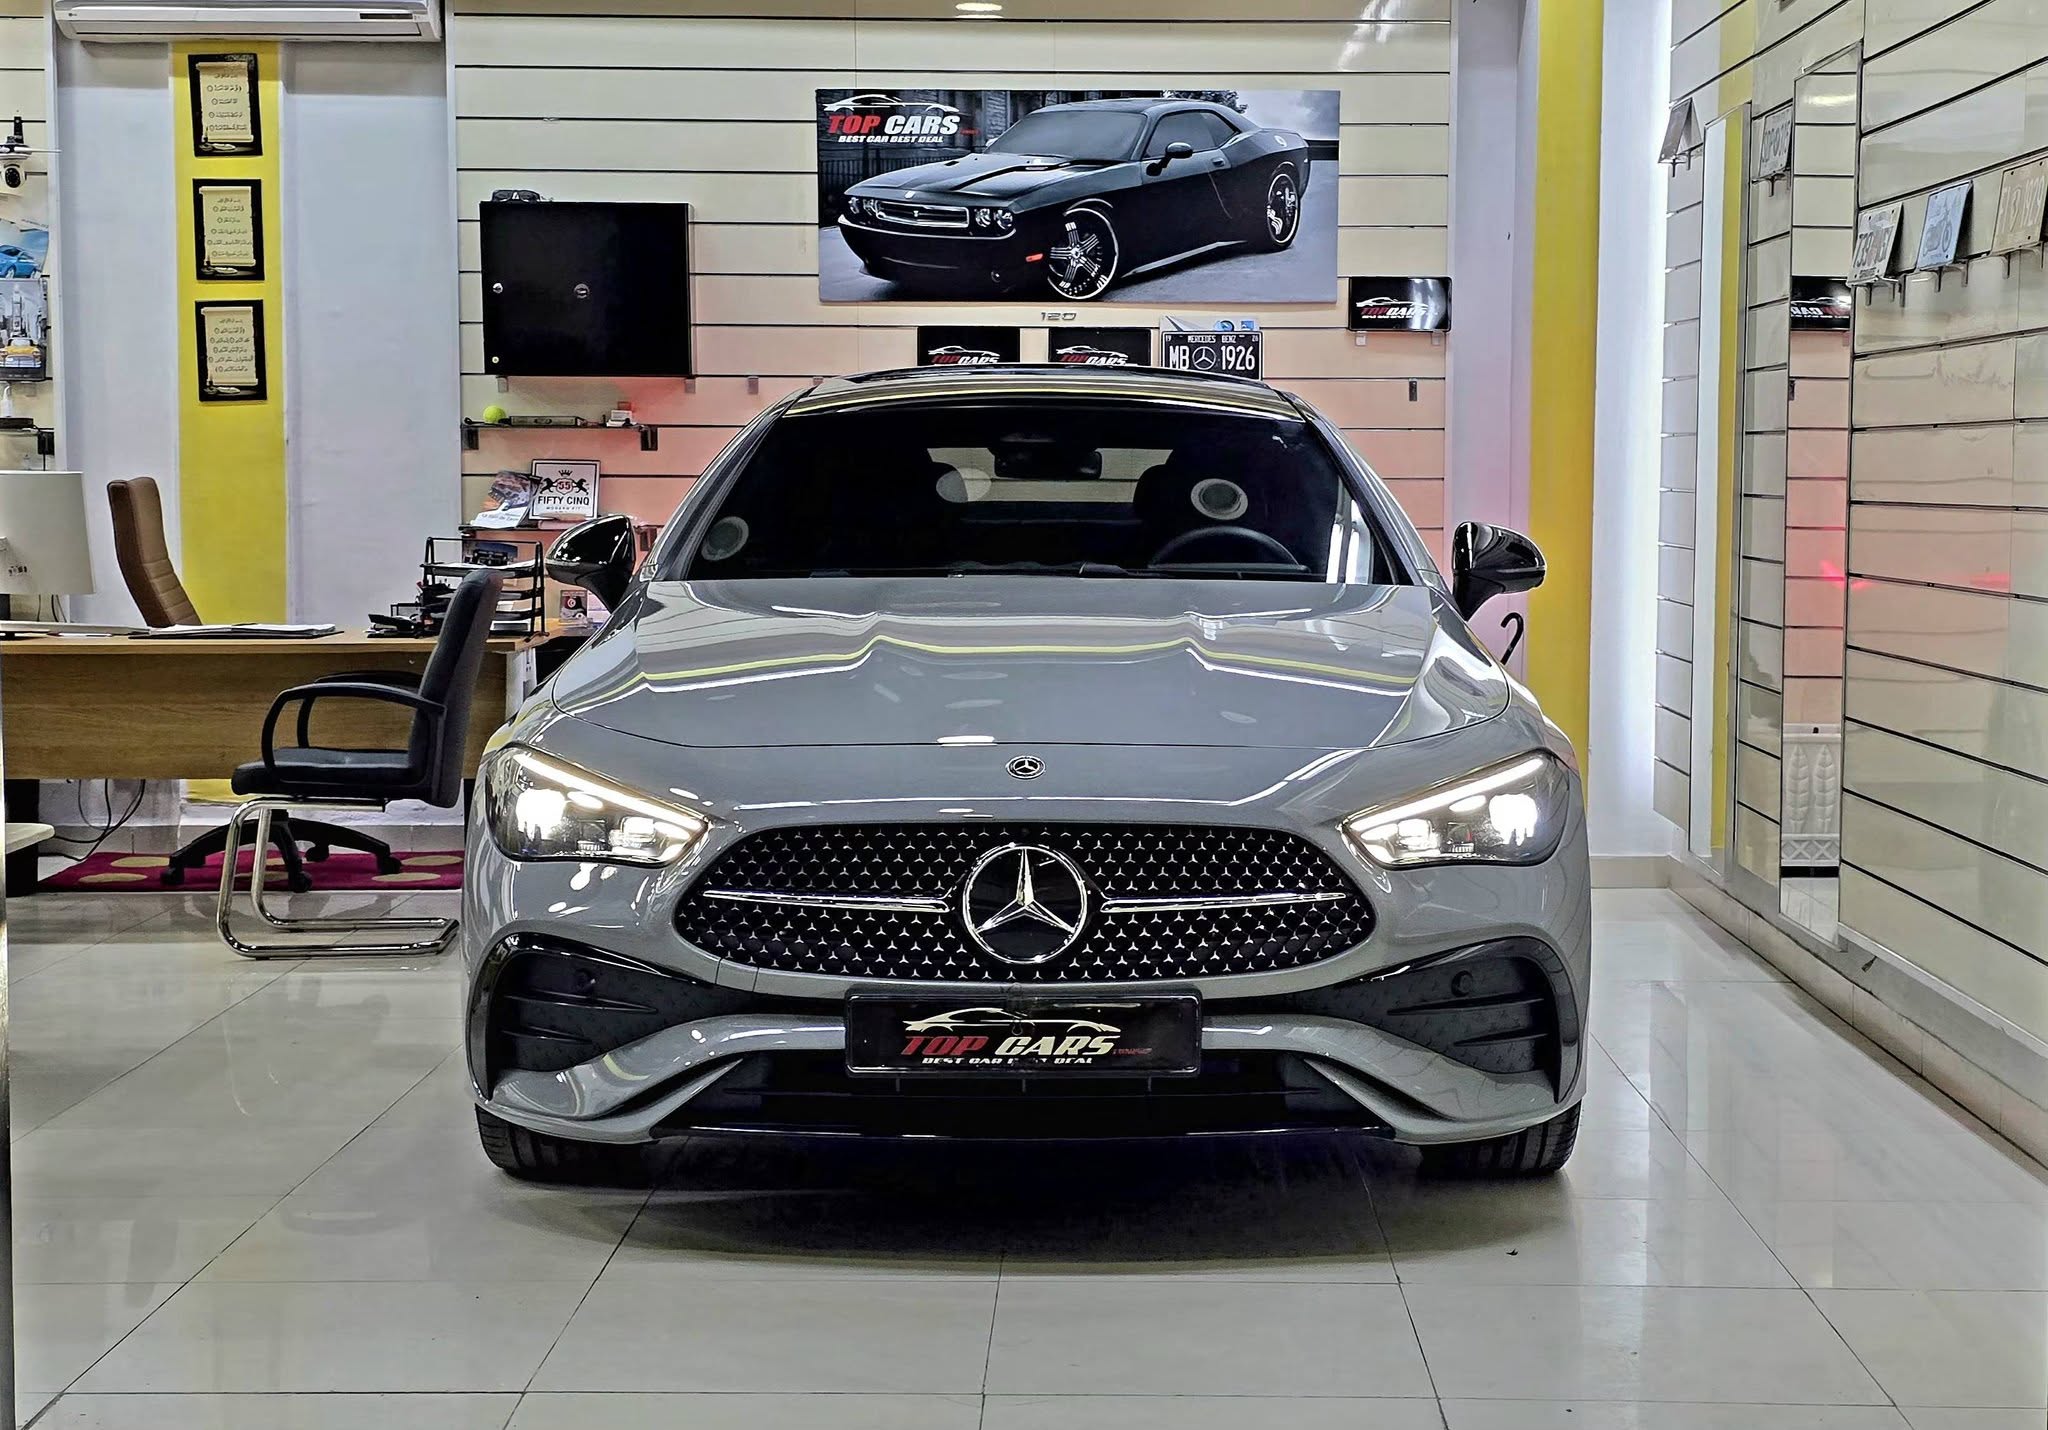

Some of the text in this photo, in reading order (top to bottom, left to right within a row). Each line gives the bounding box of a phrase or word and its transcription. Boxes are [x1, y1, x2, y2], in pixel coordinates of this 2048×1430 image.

[828, 114, 960, 135] TOP CARS
[838, 135, 944, 143] BEST CAR BEST DEAL
[1360, 306, 1388, 315] TOP
[1041, 312, 1077, 321] 120
[1187, 335, 1216, 343] MERCEDES
[1221, 335, 1237, 343] BENZ
[1169, 345, 1255, 370] MB 1926
[558, 481, 571, 490] 55
[538, 496, 590, 506] FIFTY CINQ
[900, 1035, 989, 1056] TOP
[994, 1035, 1121, 1056] CARS
